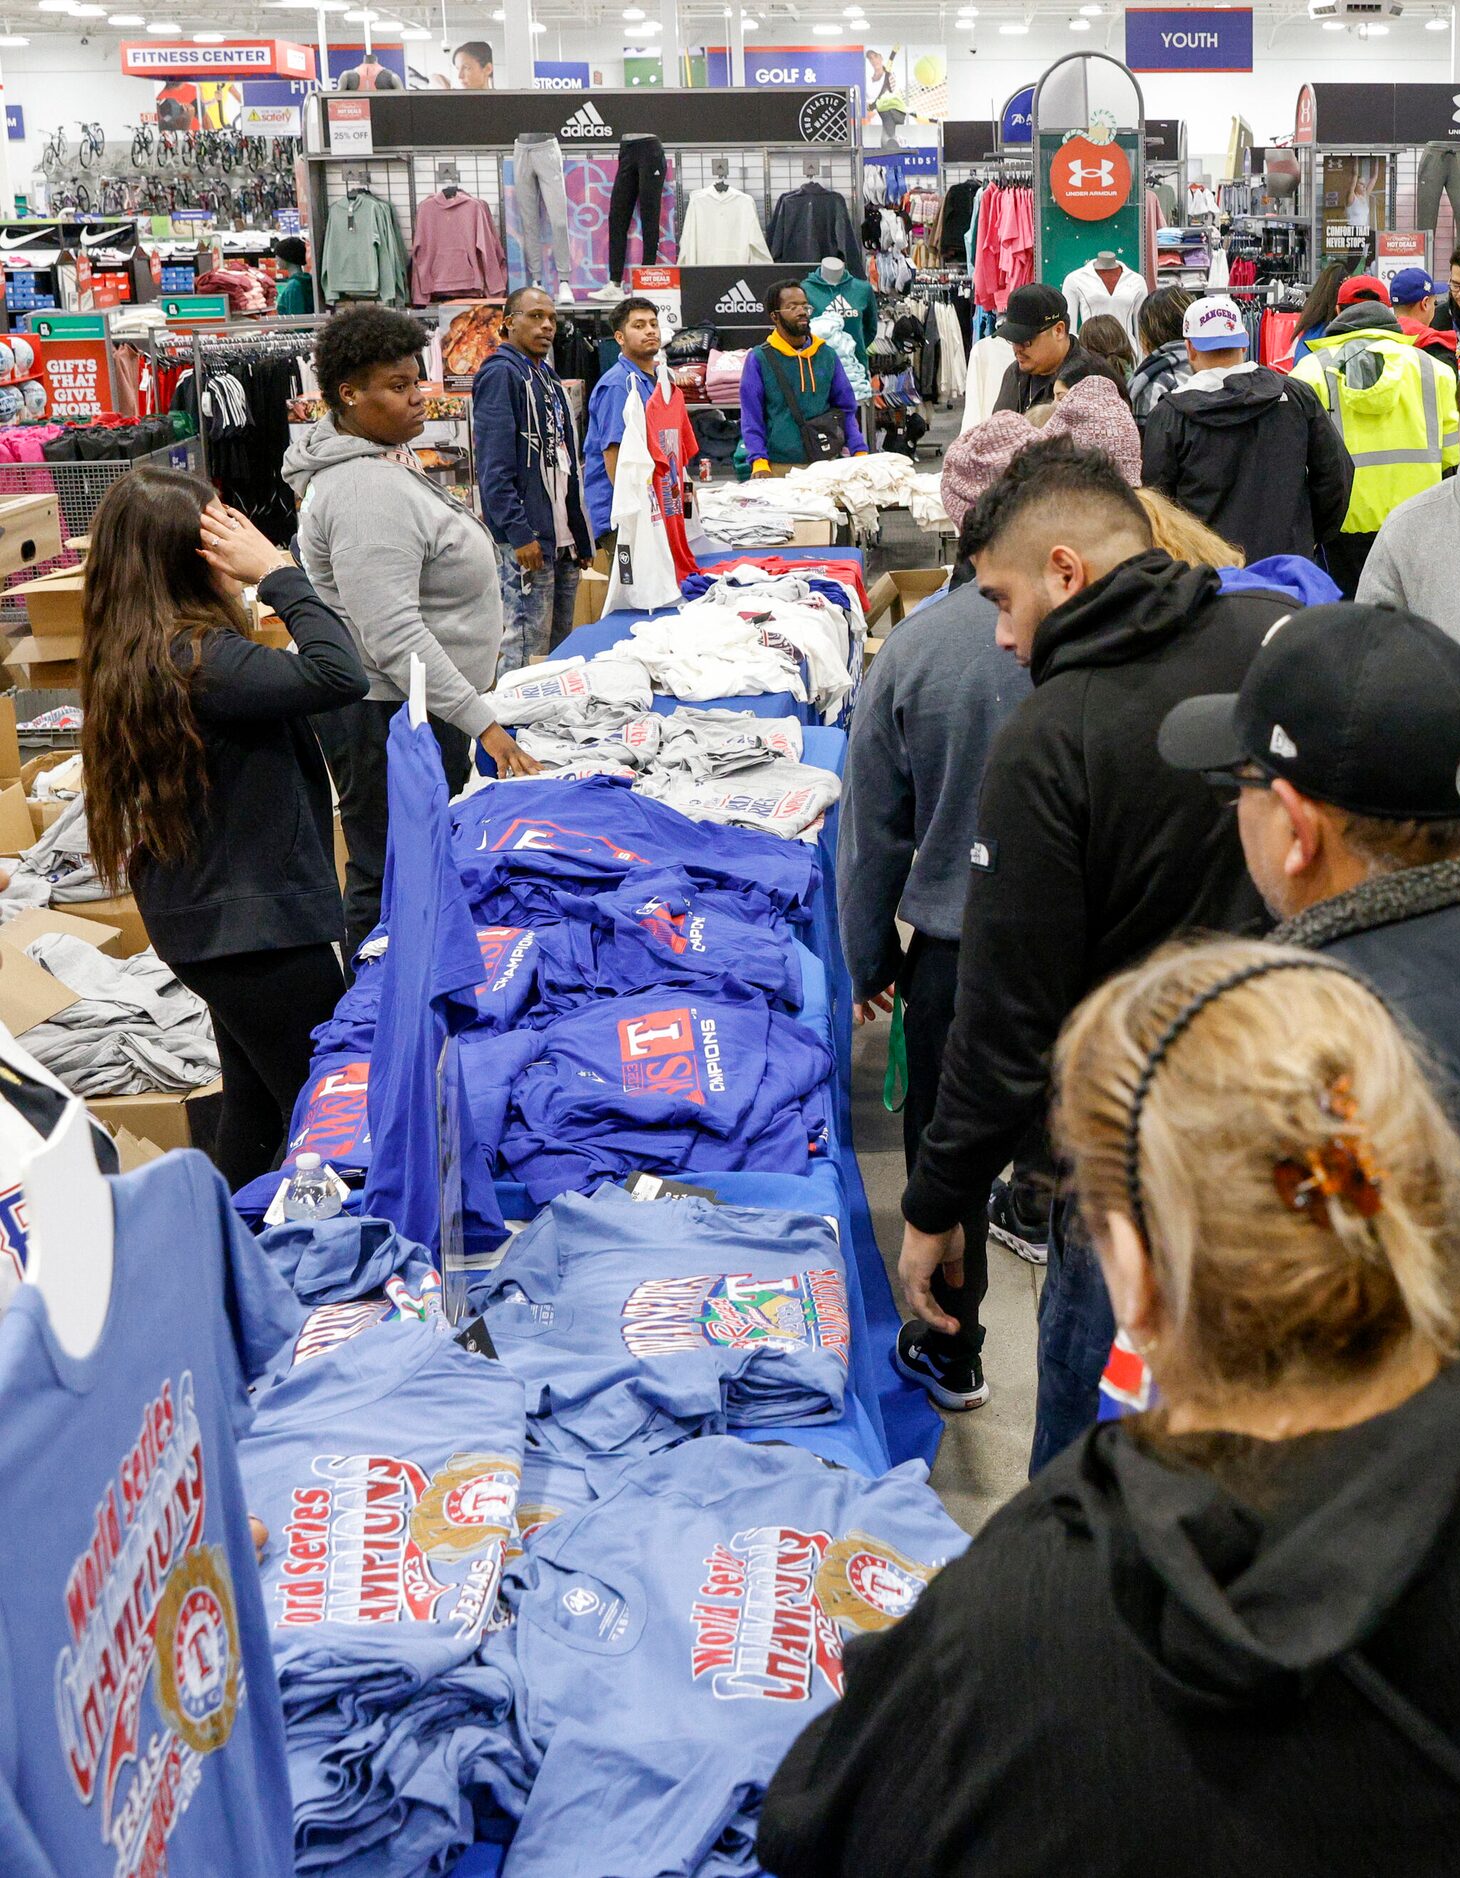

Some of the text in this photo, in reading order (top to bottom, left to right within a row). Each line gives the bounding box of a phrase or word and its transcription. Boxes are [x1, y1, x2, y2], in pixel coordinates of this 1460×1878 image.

[1161, 32, 1219, 49] YOUTH
[132, 49, 265, 63] FITNESS CENTER
[755, 68, 817, 84] GOLF &
[806, 96, 840, 115] PLASTIC
[805, 112, 814, 134] END
[813, 106, 836, 130] WASTE
[334, 131, 368, 140] 25% OFF
[560, 124, 613, 138] adidas
[1326, 225, 1370, 237] COMFORT THAT
[1326, 237, 1366, 248] NEVER STOPS
[652, 275, 671, 283] DEALS
[715, 300, 765, 313] adidas
[1199, 308, 1238, 327] RANGERS
[46, 359, 97, 373] GIFTS
[49, 373, 97, 388] THAT
[53, 388, 96, 402] GIVE
[51, 402, 101, 417] MORE
[65, 1376, 176, 1647] World Series
[275, 1485, 333, 1630] orld Series
[403, 1555, 432, 1603] 2023
[689, 1600, 742, 1682] World
